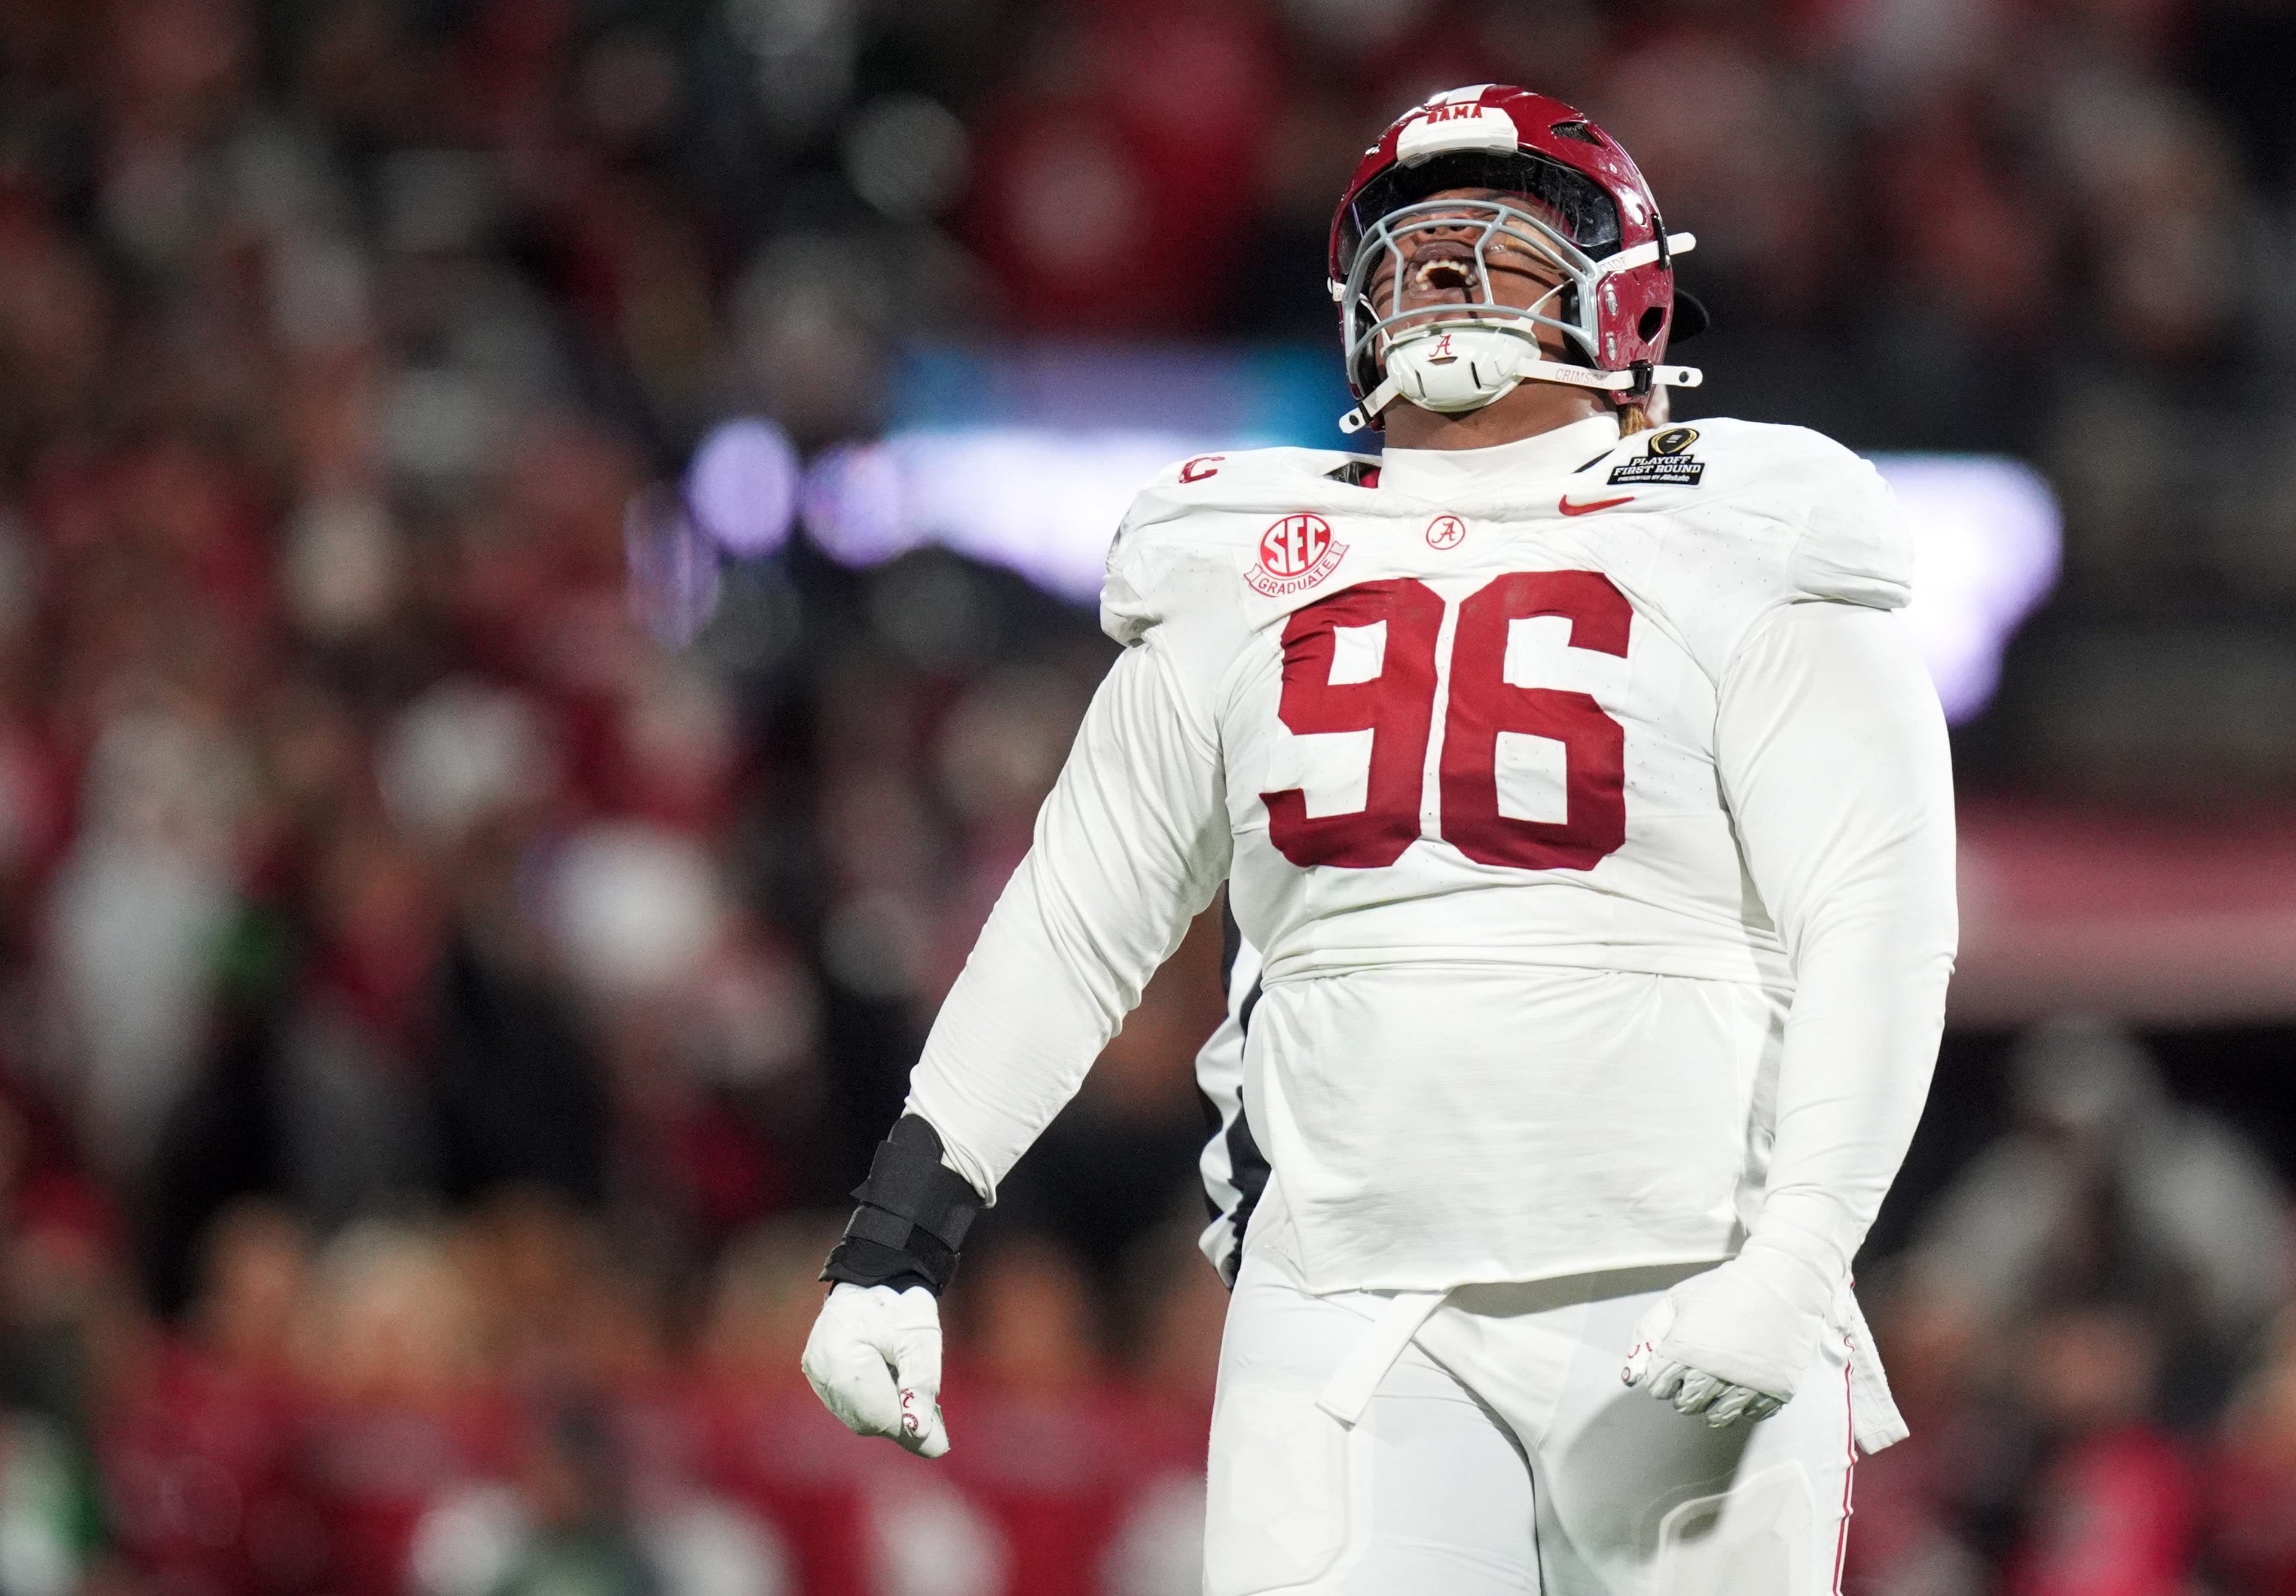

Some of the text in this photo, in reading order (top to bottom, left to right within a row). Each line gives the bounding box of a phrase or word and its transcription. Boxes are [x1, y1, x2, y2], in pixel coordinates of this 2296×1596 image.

[1428, 333, 1452, 357] A
[1178, 456, 1225, 484] C
[1614, 464, 1702, 476] FIRST ROUND
[1631, 456, 1691, 466] PLAYOFF
[1263, 516, 1327, 574] SEC
[1431, 520, 1456, 544] A
[1258, 559, 1335, 595] GRADUATE
[1259, 569, 1634, 871] 96
